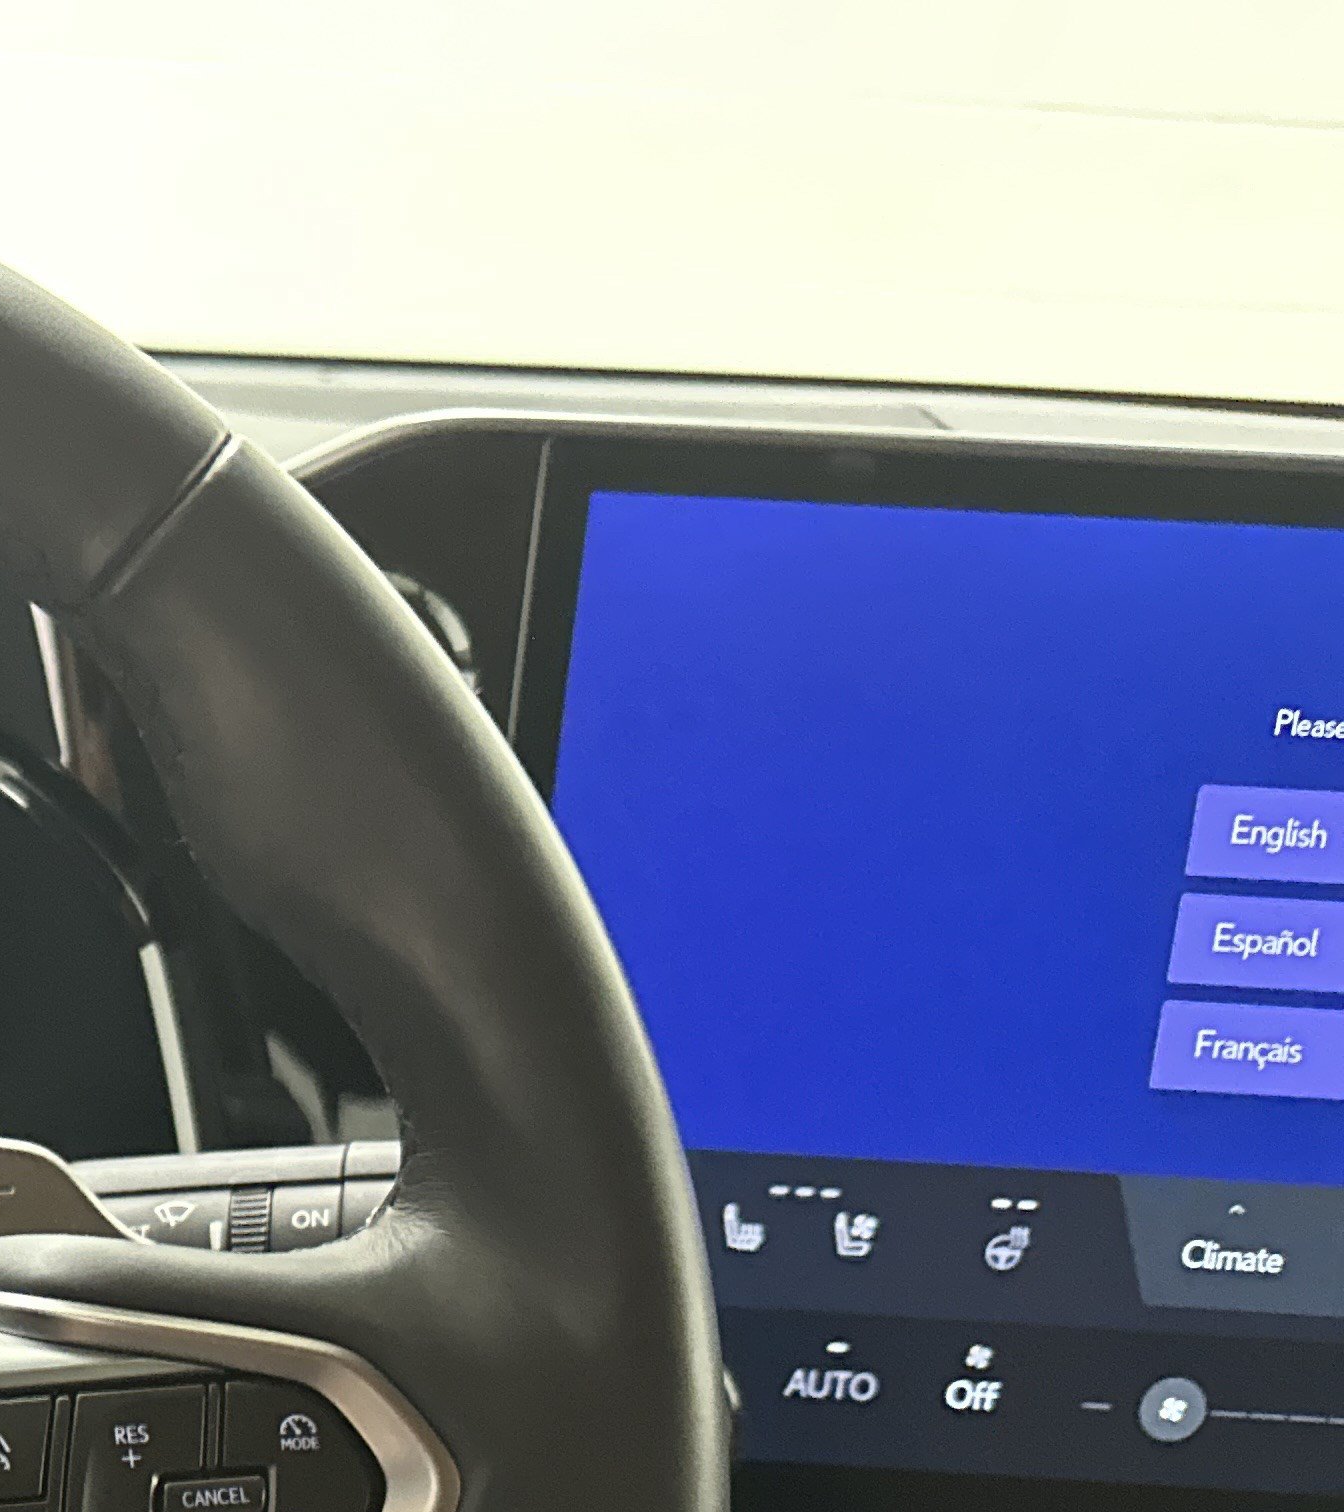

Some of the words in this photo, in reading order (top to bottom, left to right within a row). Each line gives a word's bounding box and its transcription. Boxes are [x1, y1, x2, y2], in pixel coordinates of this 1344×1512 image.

[1273, 707, 1344, 740] Please
[1230, 813, 1328, 854] English
[1212, 920, 1320, 961] Español
[1193, 1029, 1303, 1071] Français
[291, 1208, 330, 1230] ON
[1180, 1239, 1285, 1275] Climate
[782, 1368, 880, 1403] AUTO
[944, 1379, 1004, 1412] Off
[114, 1423, 150, 1446] RES
[280, 1436, 320, 1451] MODE
[181, 1486, 251, 1509] CANCEL
